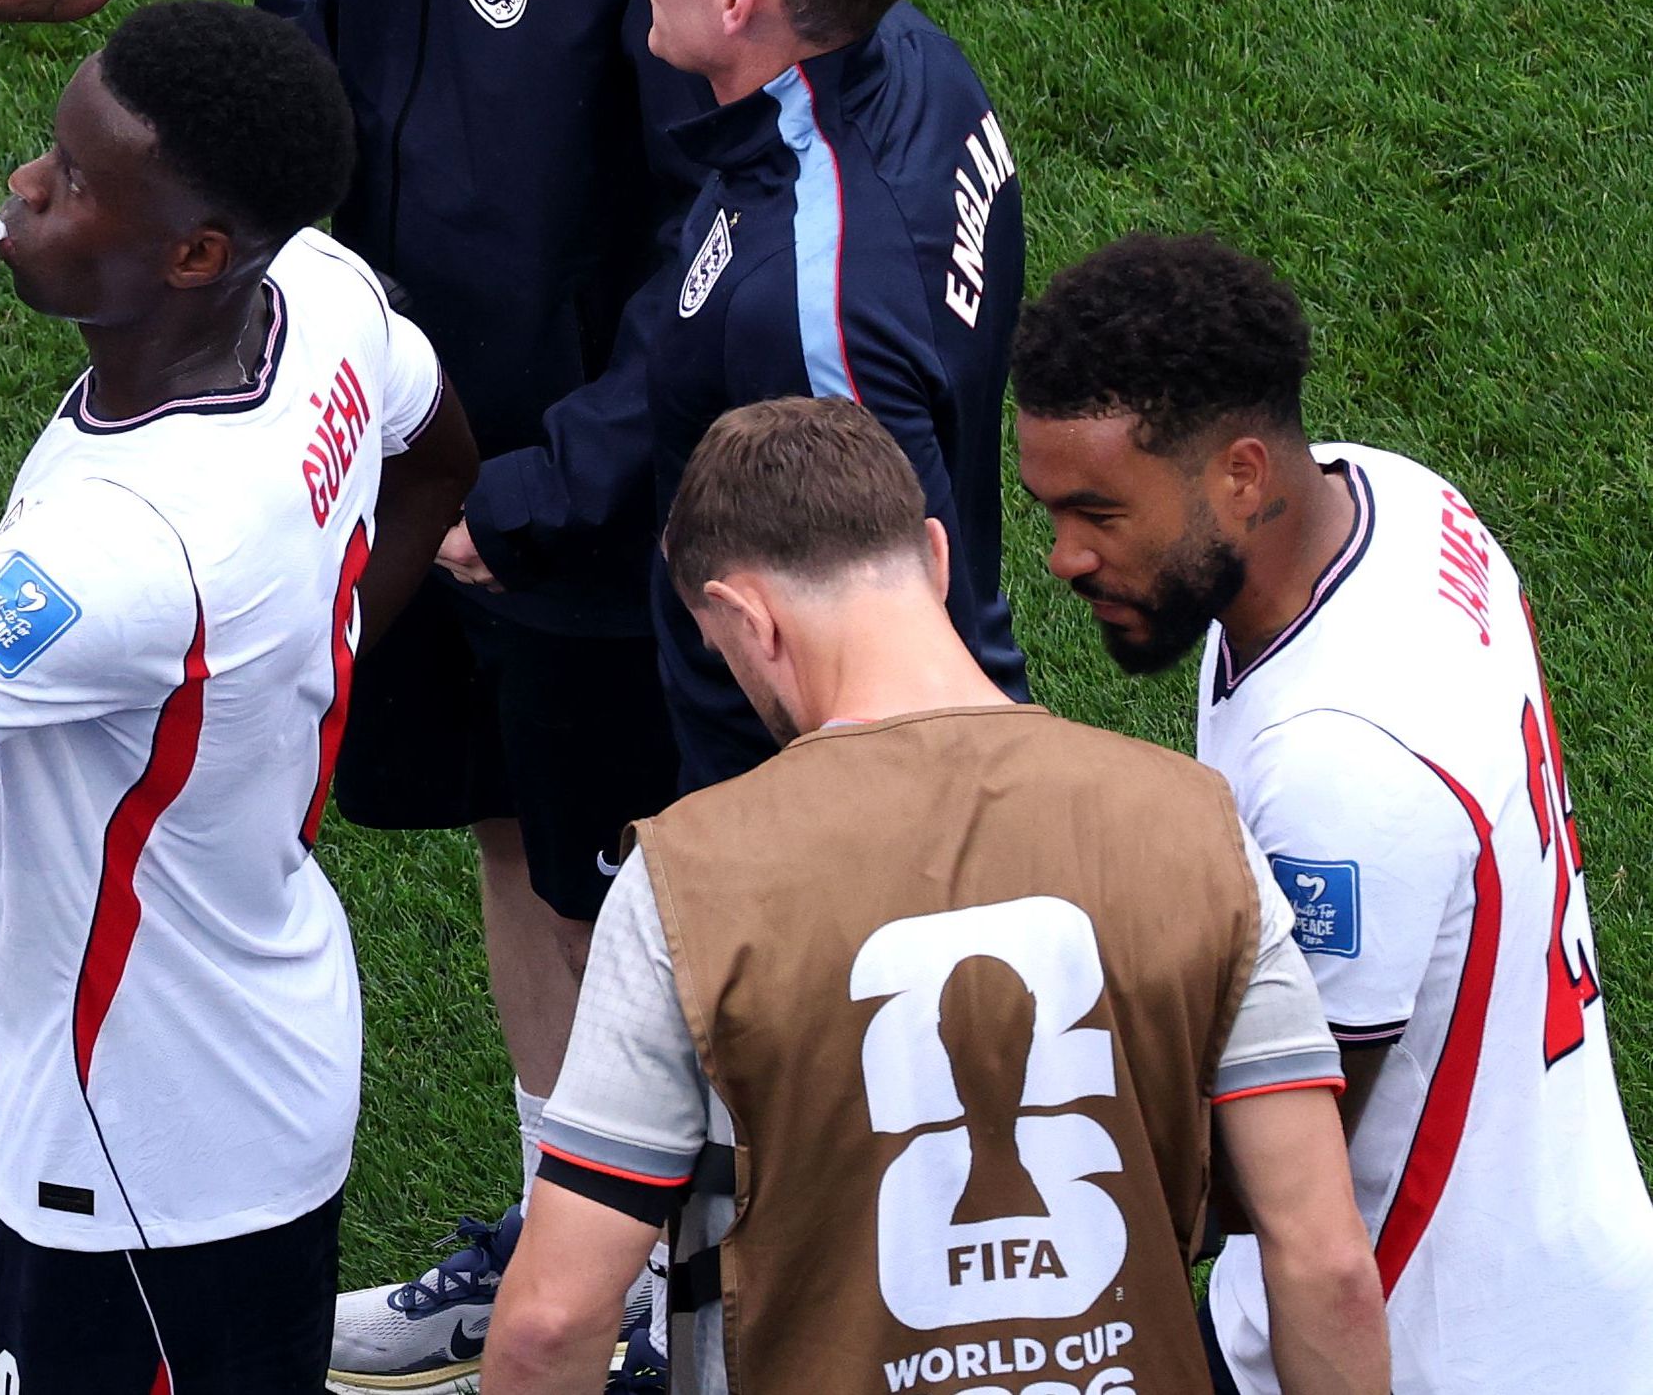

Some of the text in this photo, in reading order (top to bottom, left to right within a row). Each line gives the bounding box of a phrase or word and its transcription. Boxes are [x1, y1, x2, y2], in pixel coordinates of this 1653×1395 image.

[945, 110, 1016, 329] ENGLAN
[947, 1238, 1069, 1287] FIFA
[883, 1337, 1047, 1394] WORLD
[1054, 1320, 1134, 1372] CUP
